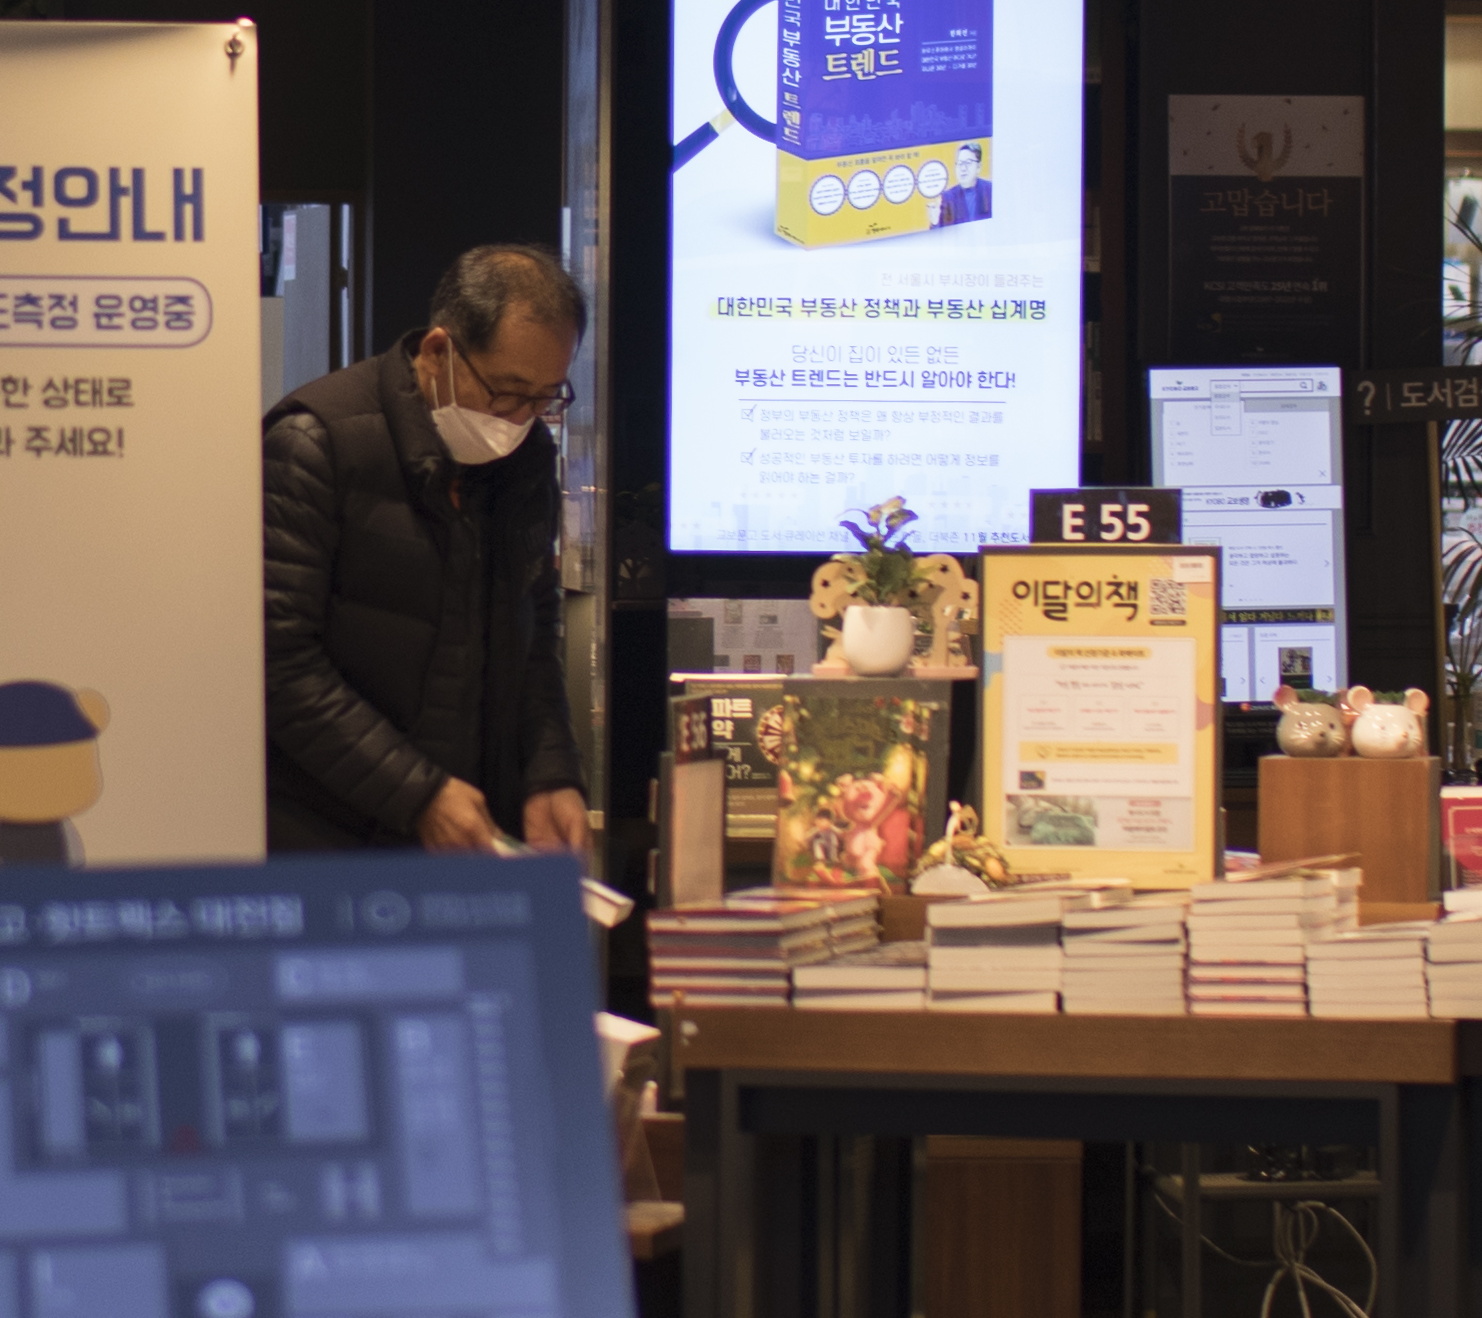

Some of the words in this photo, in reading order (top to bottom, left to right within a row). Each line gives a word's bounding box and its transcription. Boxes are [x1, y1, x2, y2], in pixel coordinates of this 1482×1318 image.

[824, 13, 903, 46] 부동산
[822, 48, 903, 81] 트렌드
[1200, 189, 1334, 217] 고맙습니다
[881, 273, 892, 288] 전
[897, 273, 934, 288] 서울시
[939, 273, 989, 288] 부시장이
[994, 273, 1044, 288] 들려주는
[92, 289, 196, 333] 운영중
[717, 297, 792, 317] 대한민국
[800, 298, 857, 318] 부동산
[864, 298, 921, 319] 정책과
[927, 299, 985, 319] 부동산
[990, 300, 1046, 320] 십계명
[791, 345, 842, 364] 당신이
[848, 345, 881, 364] 집이
[887, 345, 920, 364] 있든
[926, 345, 959, 364] 없든
[735, 369, 785, 389] 부동산
[791, 369, 859, 389] 트렌드는
[864, 369, 915, 389] 반드시
[921, 369, 972, 389] 알아야
[977, 369, 1016, 389] 한다!
[40, 373, 134, 411] 상태로
[760, 410, 794, 424] 정부의
[799, 410, 833, 424] 부동산
[837, 410, 872, 424] 정책은
[891, 410, 914, 424] 항상
[919, 410, 964, 424] 부정적인
[969, 410, 1004, 424] 결과를
[24, 423, 126, 461] 주세요!
[759, 428, 804, 442] 불러오는
[811, 428, 844, 442] 것처럼
[848, 428, 891, 442] 보일까?
[759, 452, 806, 467] 성공적인
[810, 452, 845, 467] 부동산
[849, 452, 883, 467] 투자를
[887, 452, 922, 467] 하려면
[926, 452, 960, 467] 어떻게
[965, 452, 1000, 467] 정보를
[759, 471, 794, 484] 읽어야
[798, 471, 820, 484] 하는
[824, 471, 856, 484] 걸까?
[1061, 503, 1086, 541] E
[1099, 503, 1152, 541] 55
[964, 530, 987, 543] 11월
